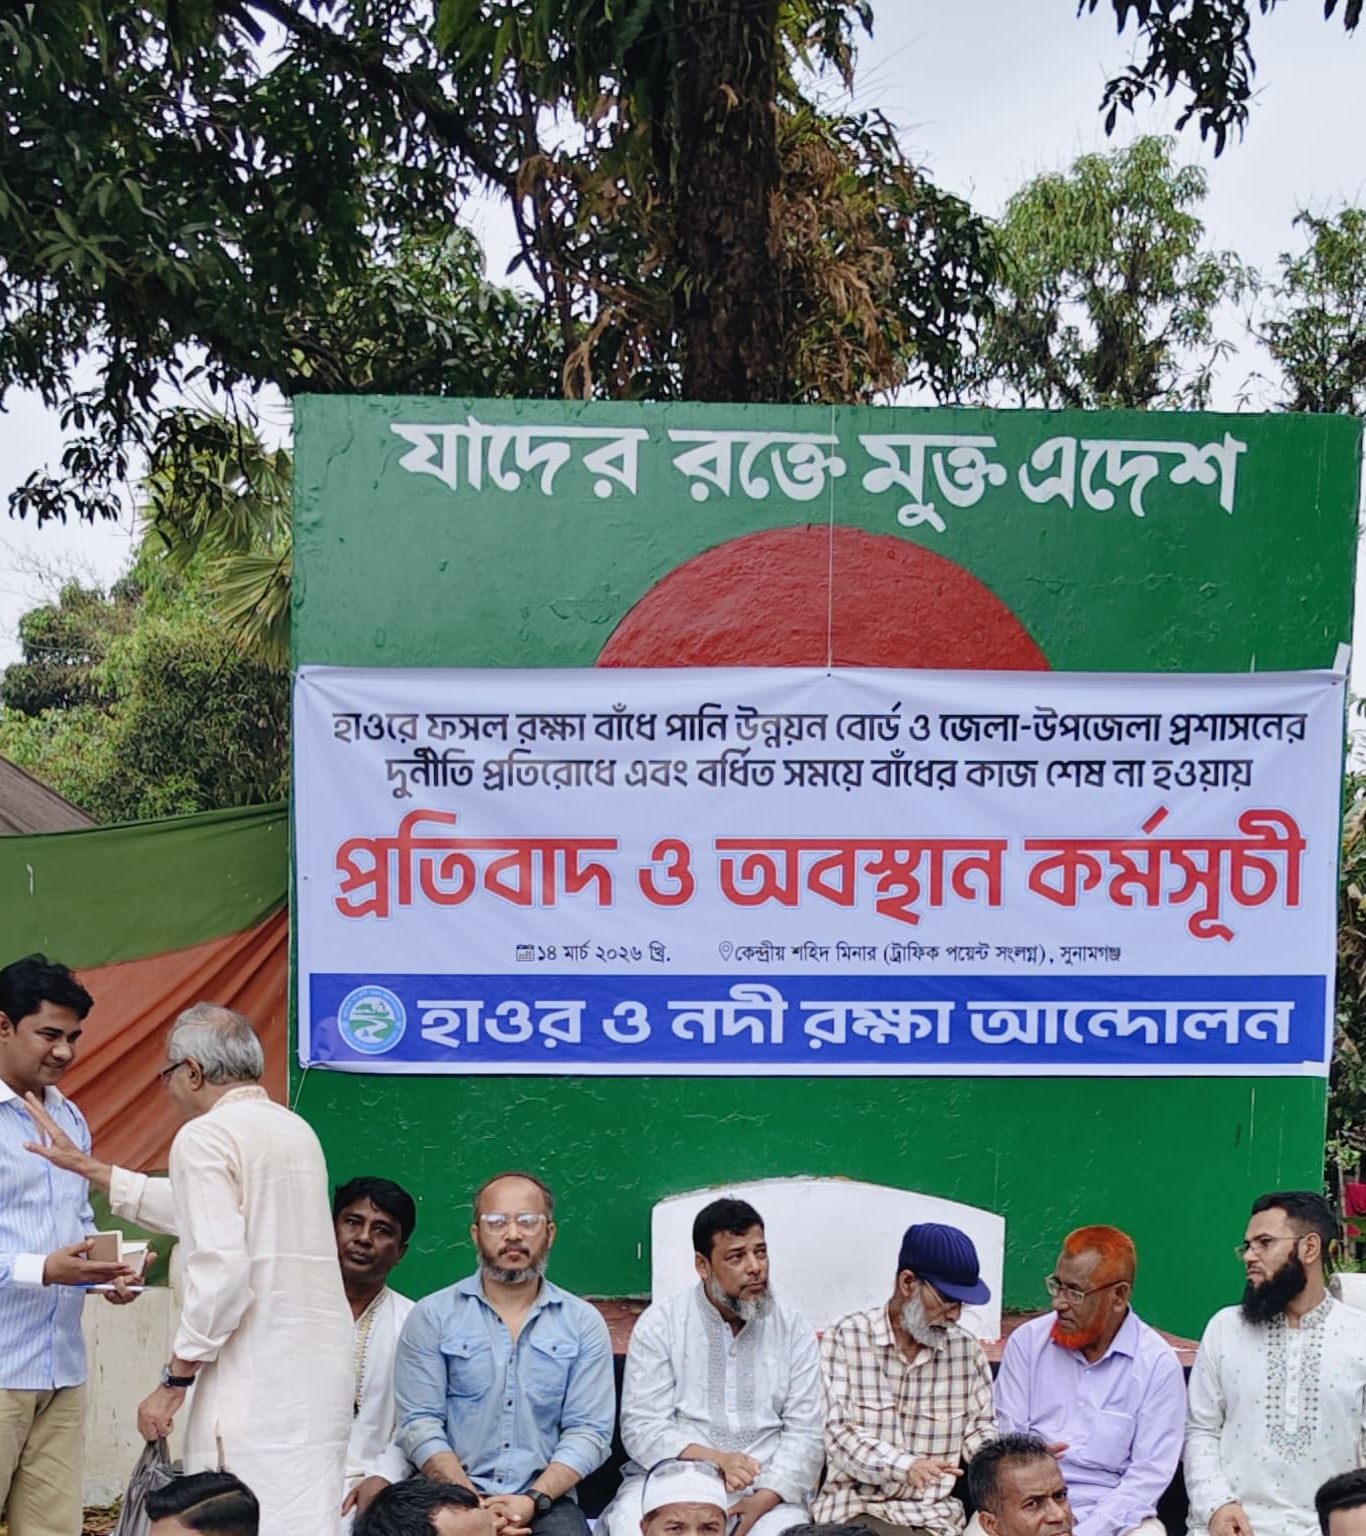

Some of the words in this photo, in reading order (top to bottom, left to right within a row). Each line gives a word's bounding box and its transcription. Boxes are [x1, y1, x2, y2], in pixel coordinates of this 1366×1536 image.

[390, 415, 650, 498] যাদের
[667, 429, 846, 502] রক্তে
[859, 434, 1007, 532] মুক্ত
[1018, 433, 1247, 517] এদেশ
[332, 712, 420, 744] হাওরে
[425, 713, 510, 741] ফসল
[515, 713, 587, 745] রক্ষা
[592, 703, 658, 741] বাঁধে
[665, 702, 729, 742] পানি
[734, 705, 829, 749] উন্নয়ন
[836, 701, 902, 742] বোর্ড
[909, 714, 931, 742] ও
[938, 706, 1163, 742] জেলা-উপজেলা
[1168, 713, 1308, 746] প্রশাসনের
[482, 747, 617, 791] প্রতিরোধে
[625, 759, 688, 787] এবং
[696, 747, 777, 787] বর্ধিত
[782, 759, 865, 792] সময়ে
[870, 748, 959, 791] বাঁধের
[964, 760, 1039, 788] কাজ
[1046, 759, 1107, 788] শেষ
[1112, 759, 1147, 788] না
[1151, 759, 1254, 792] হওয়ায়
[336, 809, 617, 917] প্রতিবাদ
[639, 839, 694, 905] ও
[715, 839, 1007, 925] অবস্থান
[1024, 808, 1306, 941] কর্মসূচী
[538, 945, 557, 961] ১৪
[562, 941, 589, 961] মার্চ
[595, 946, 642, 961] ২০২৬
[791, 940, 830, 961] শহিদ
[835, 940, 877, 961] মিনার
[417, 1000, 586, 1048] হাওর
[602, 1001, 651, 1043] ও
[667, 983, 789, 1043] নদী
[800, 1001, 955, 1049] রক্ষা
[967, 1001, 1295, 1044] আন্দোলন
